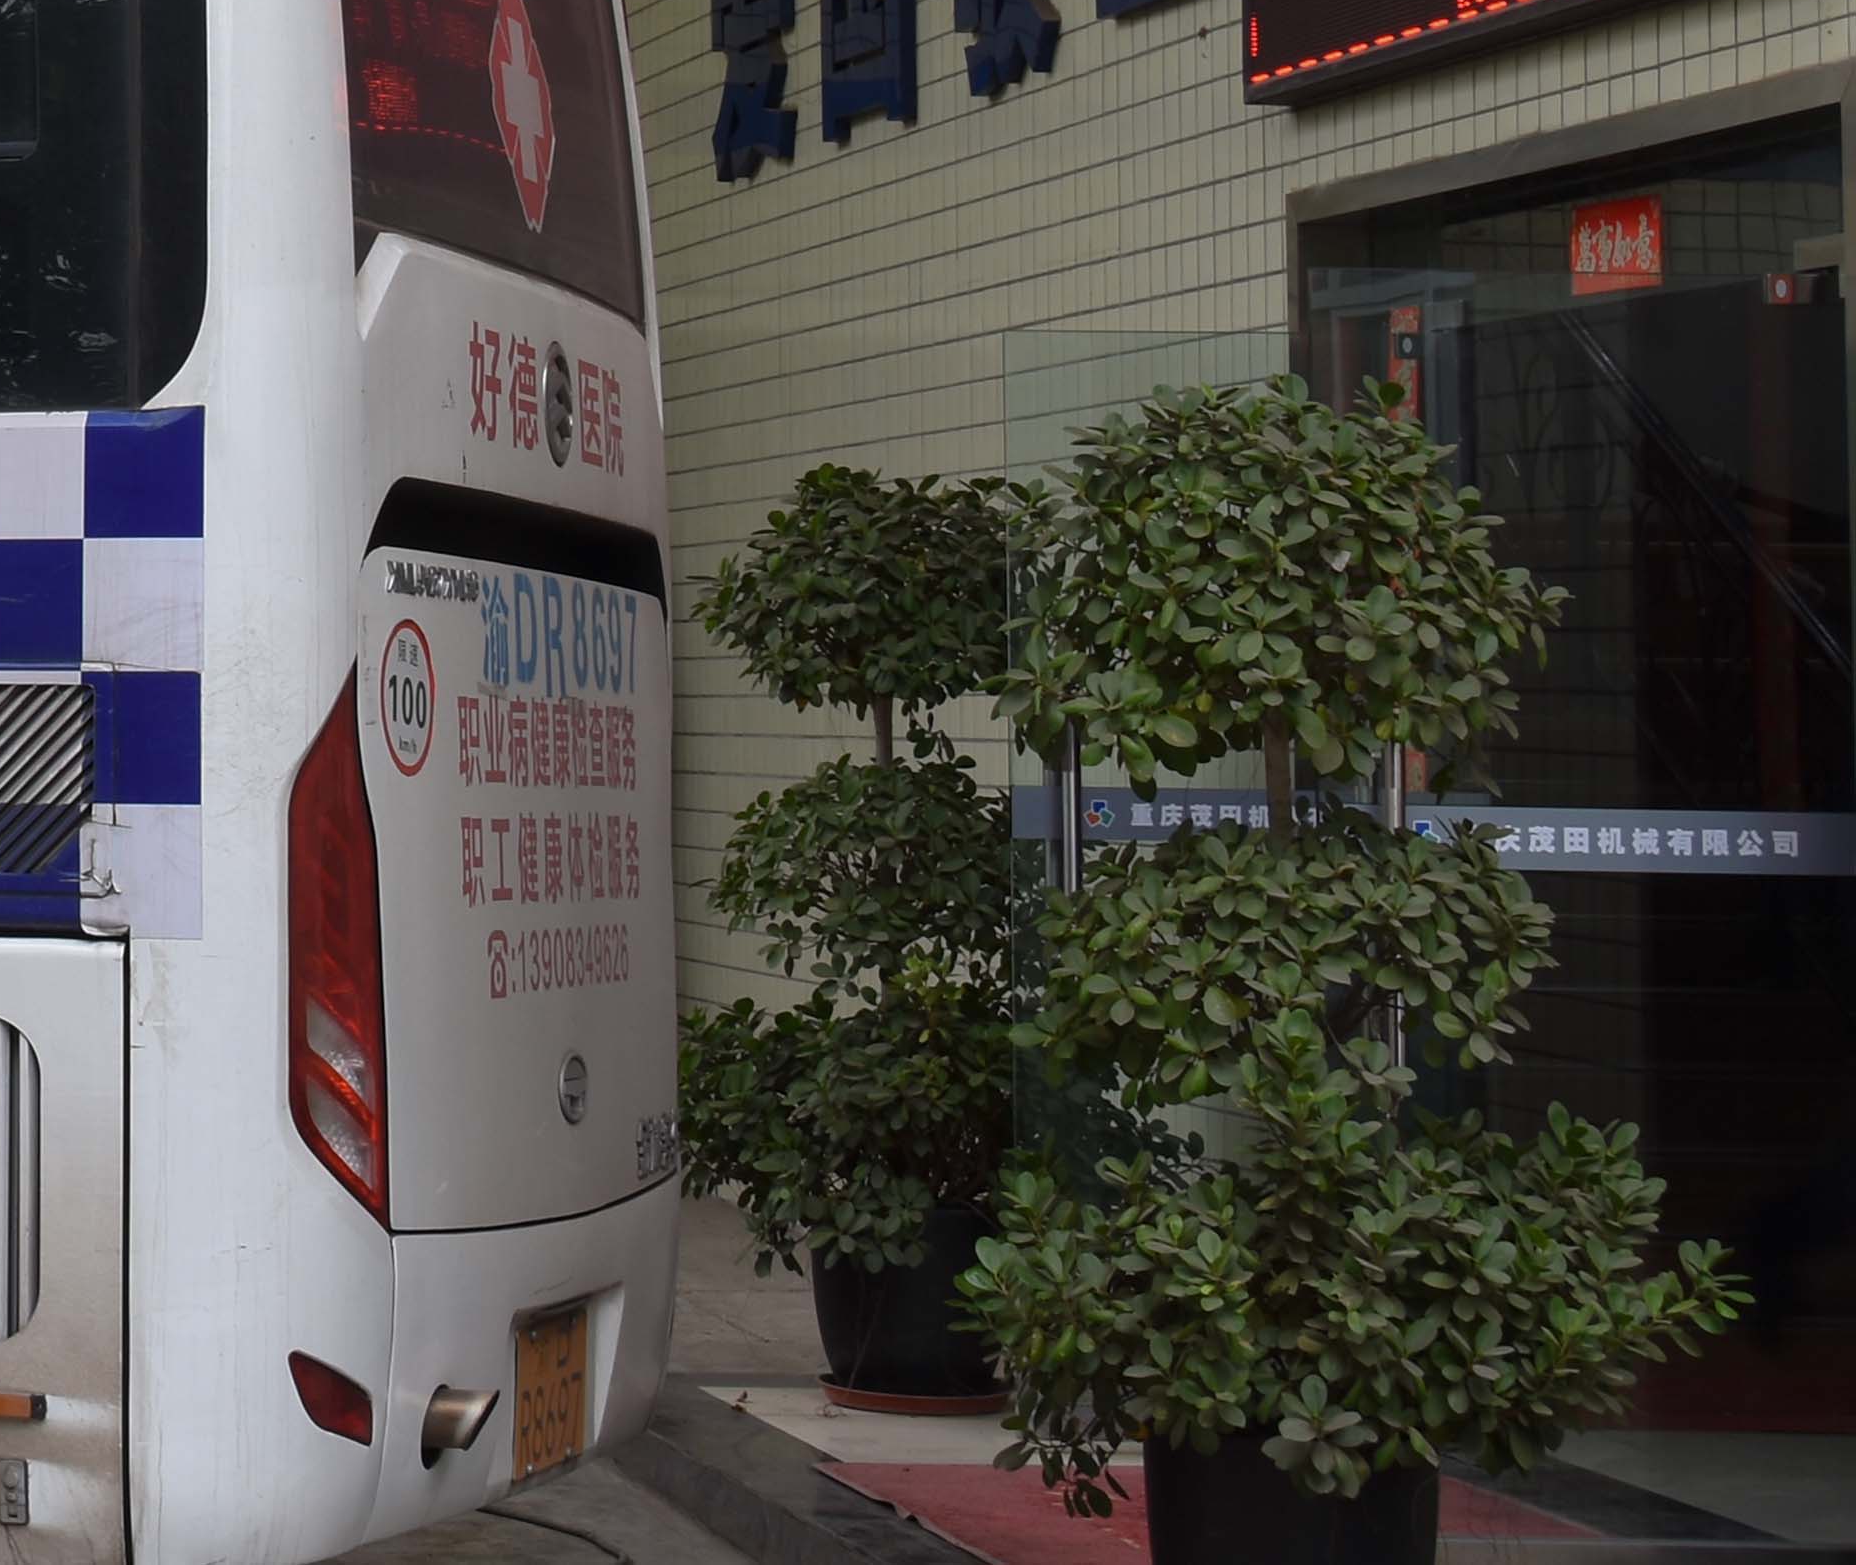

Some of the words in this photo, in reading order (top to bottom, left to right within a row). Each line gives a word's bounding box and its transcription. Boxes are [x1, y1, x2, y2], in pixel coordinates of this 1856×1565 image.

[469, 320, 538, 449] 好德
[577, 359, 624, 477] 医院
[481, 573, 637, 698] 渝DR8697
[389, 674, 427, 729] 100
[457, 695, 636, 790] 职业病健康检查服务
[461, 812, 639, 908] 职工健康体检服务
[1494, 825, 1800, 857] 庆茂田机械有限公司
